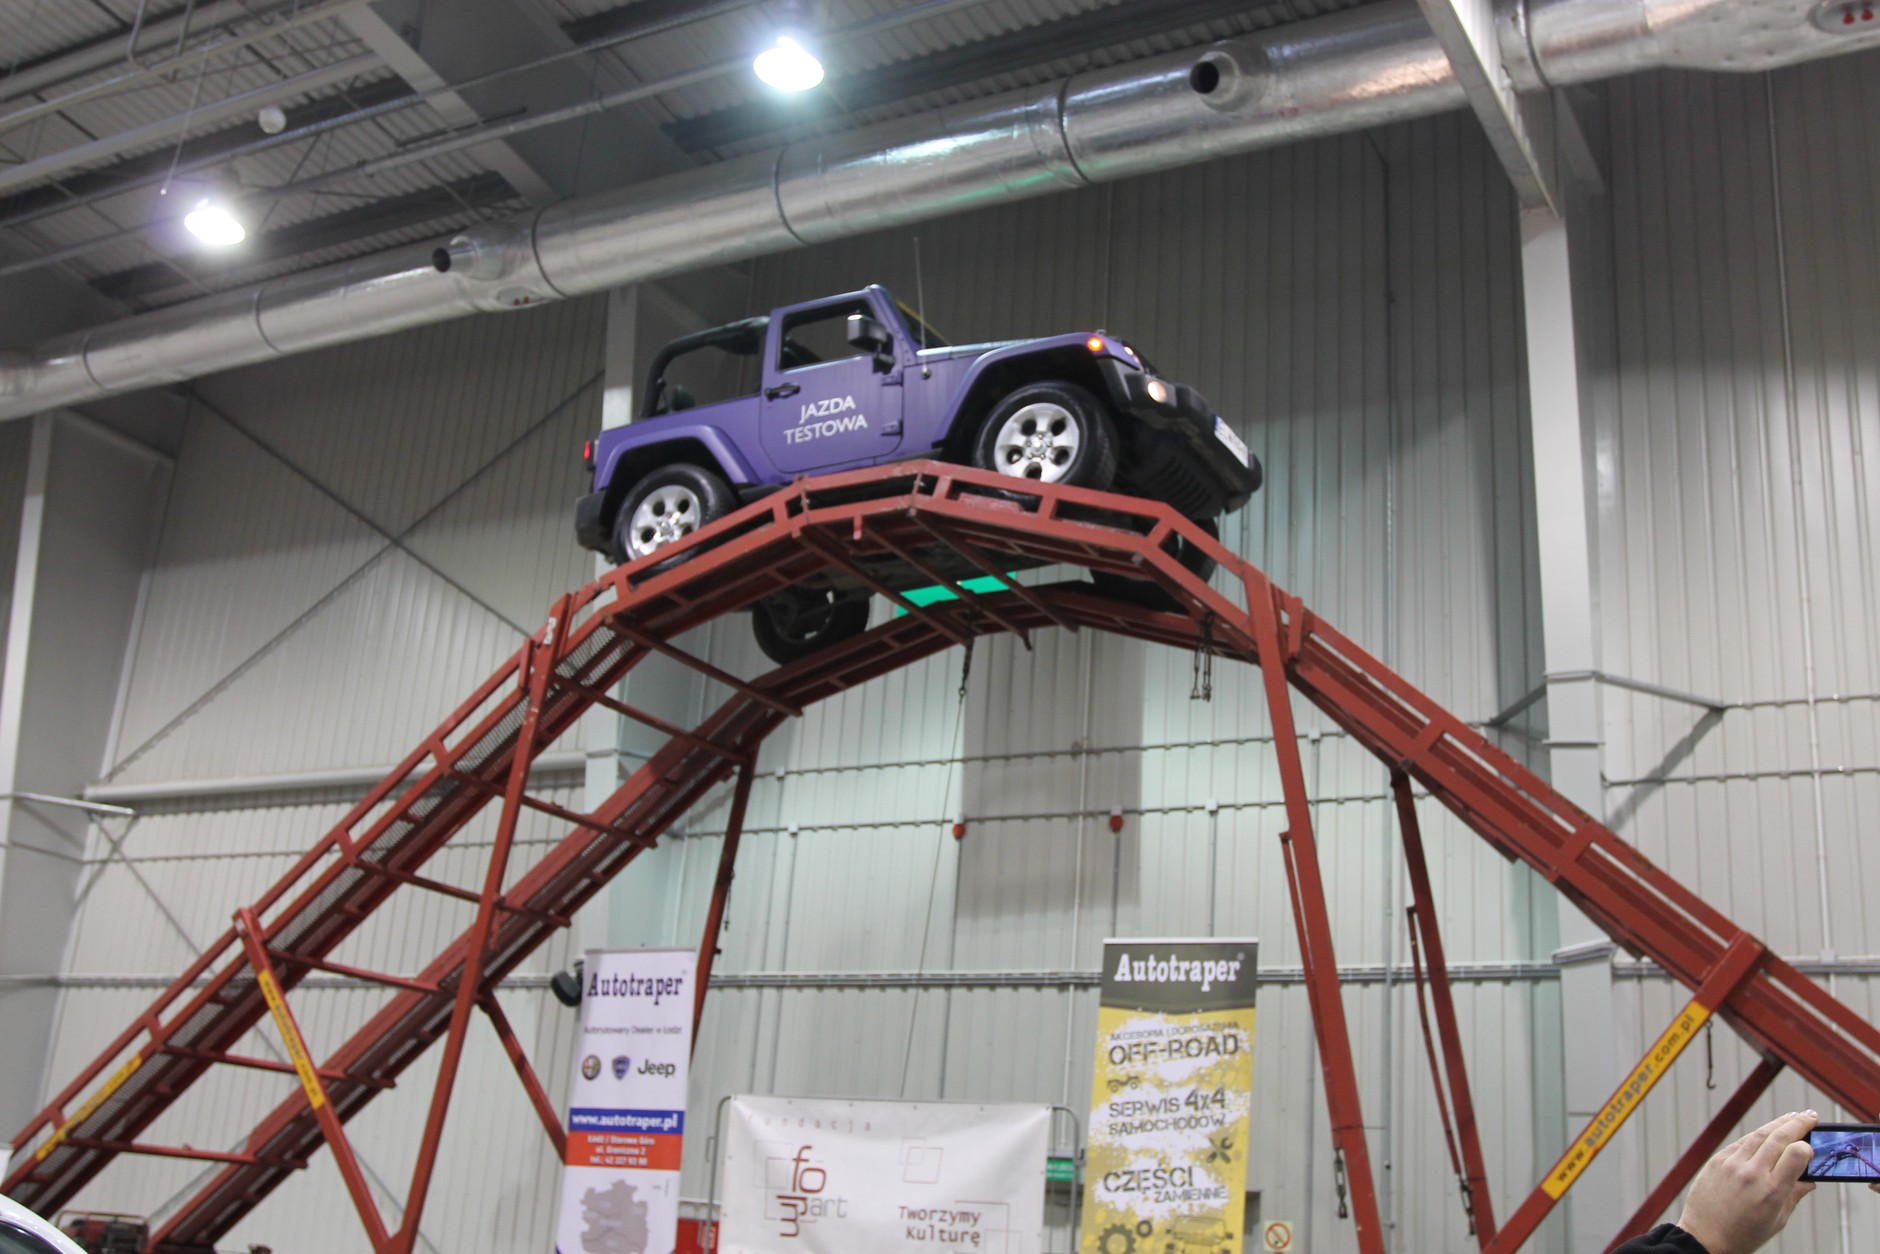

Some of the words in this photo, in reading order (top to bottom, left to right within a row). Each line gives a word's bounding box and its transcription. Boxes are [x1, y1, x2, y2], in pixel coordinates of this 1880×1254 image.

[799, 395, 856, 424] JAZDA
[784, 414, 868, 445] TESTOWA
[1113, 953, 1241, 992] Autotraper
[587, 972, 683, 1006] Autotraper
[1109, 1034, 1240, 1066] OFF-ROAD
[637, 1059, 676, 1078] Jeep
[1109, 1097, 1180, 1118] SERWIS
[1185, 1087, 1226, 1112] 4x4
[571, 1113, 679, 1132] www.autotraper.pl
[1154, 1185, 1228, 1204] ZAMIENNE
[899, 1206, 981, 1226] Tworzymy
[905, 1225, 981, 1247] Kulturę
